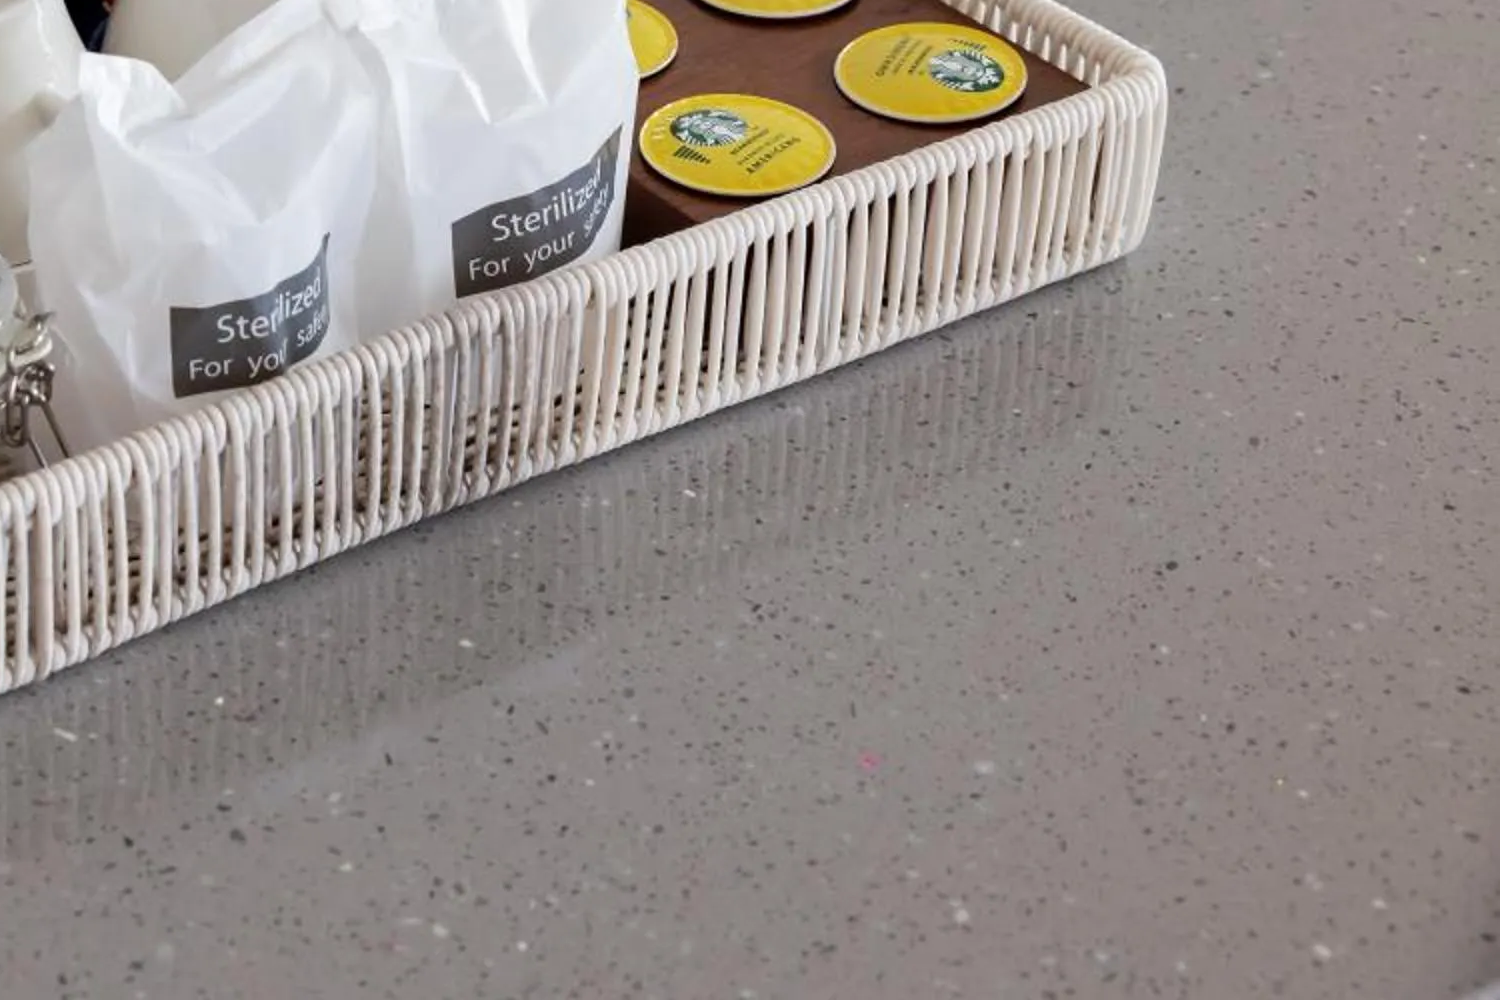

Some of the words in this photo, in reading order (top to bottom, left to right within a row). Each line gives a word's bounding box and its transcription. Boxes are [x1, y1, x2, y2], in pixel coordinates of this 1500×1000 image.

[468, 256, 511, 281] For
[523, 230, 576, 273] your
[189, 357, 234, 382] For
